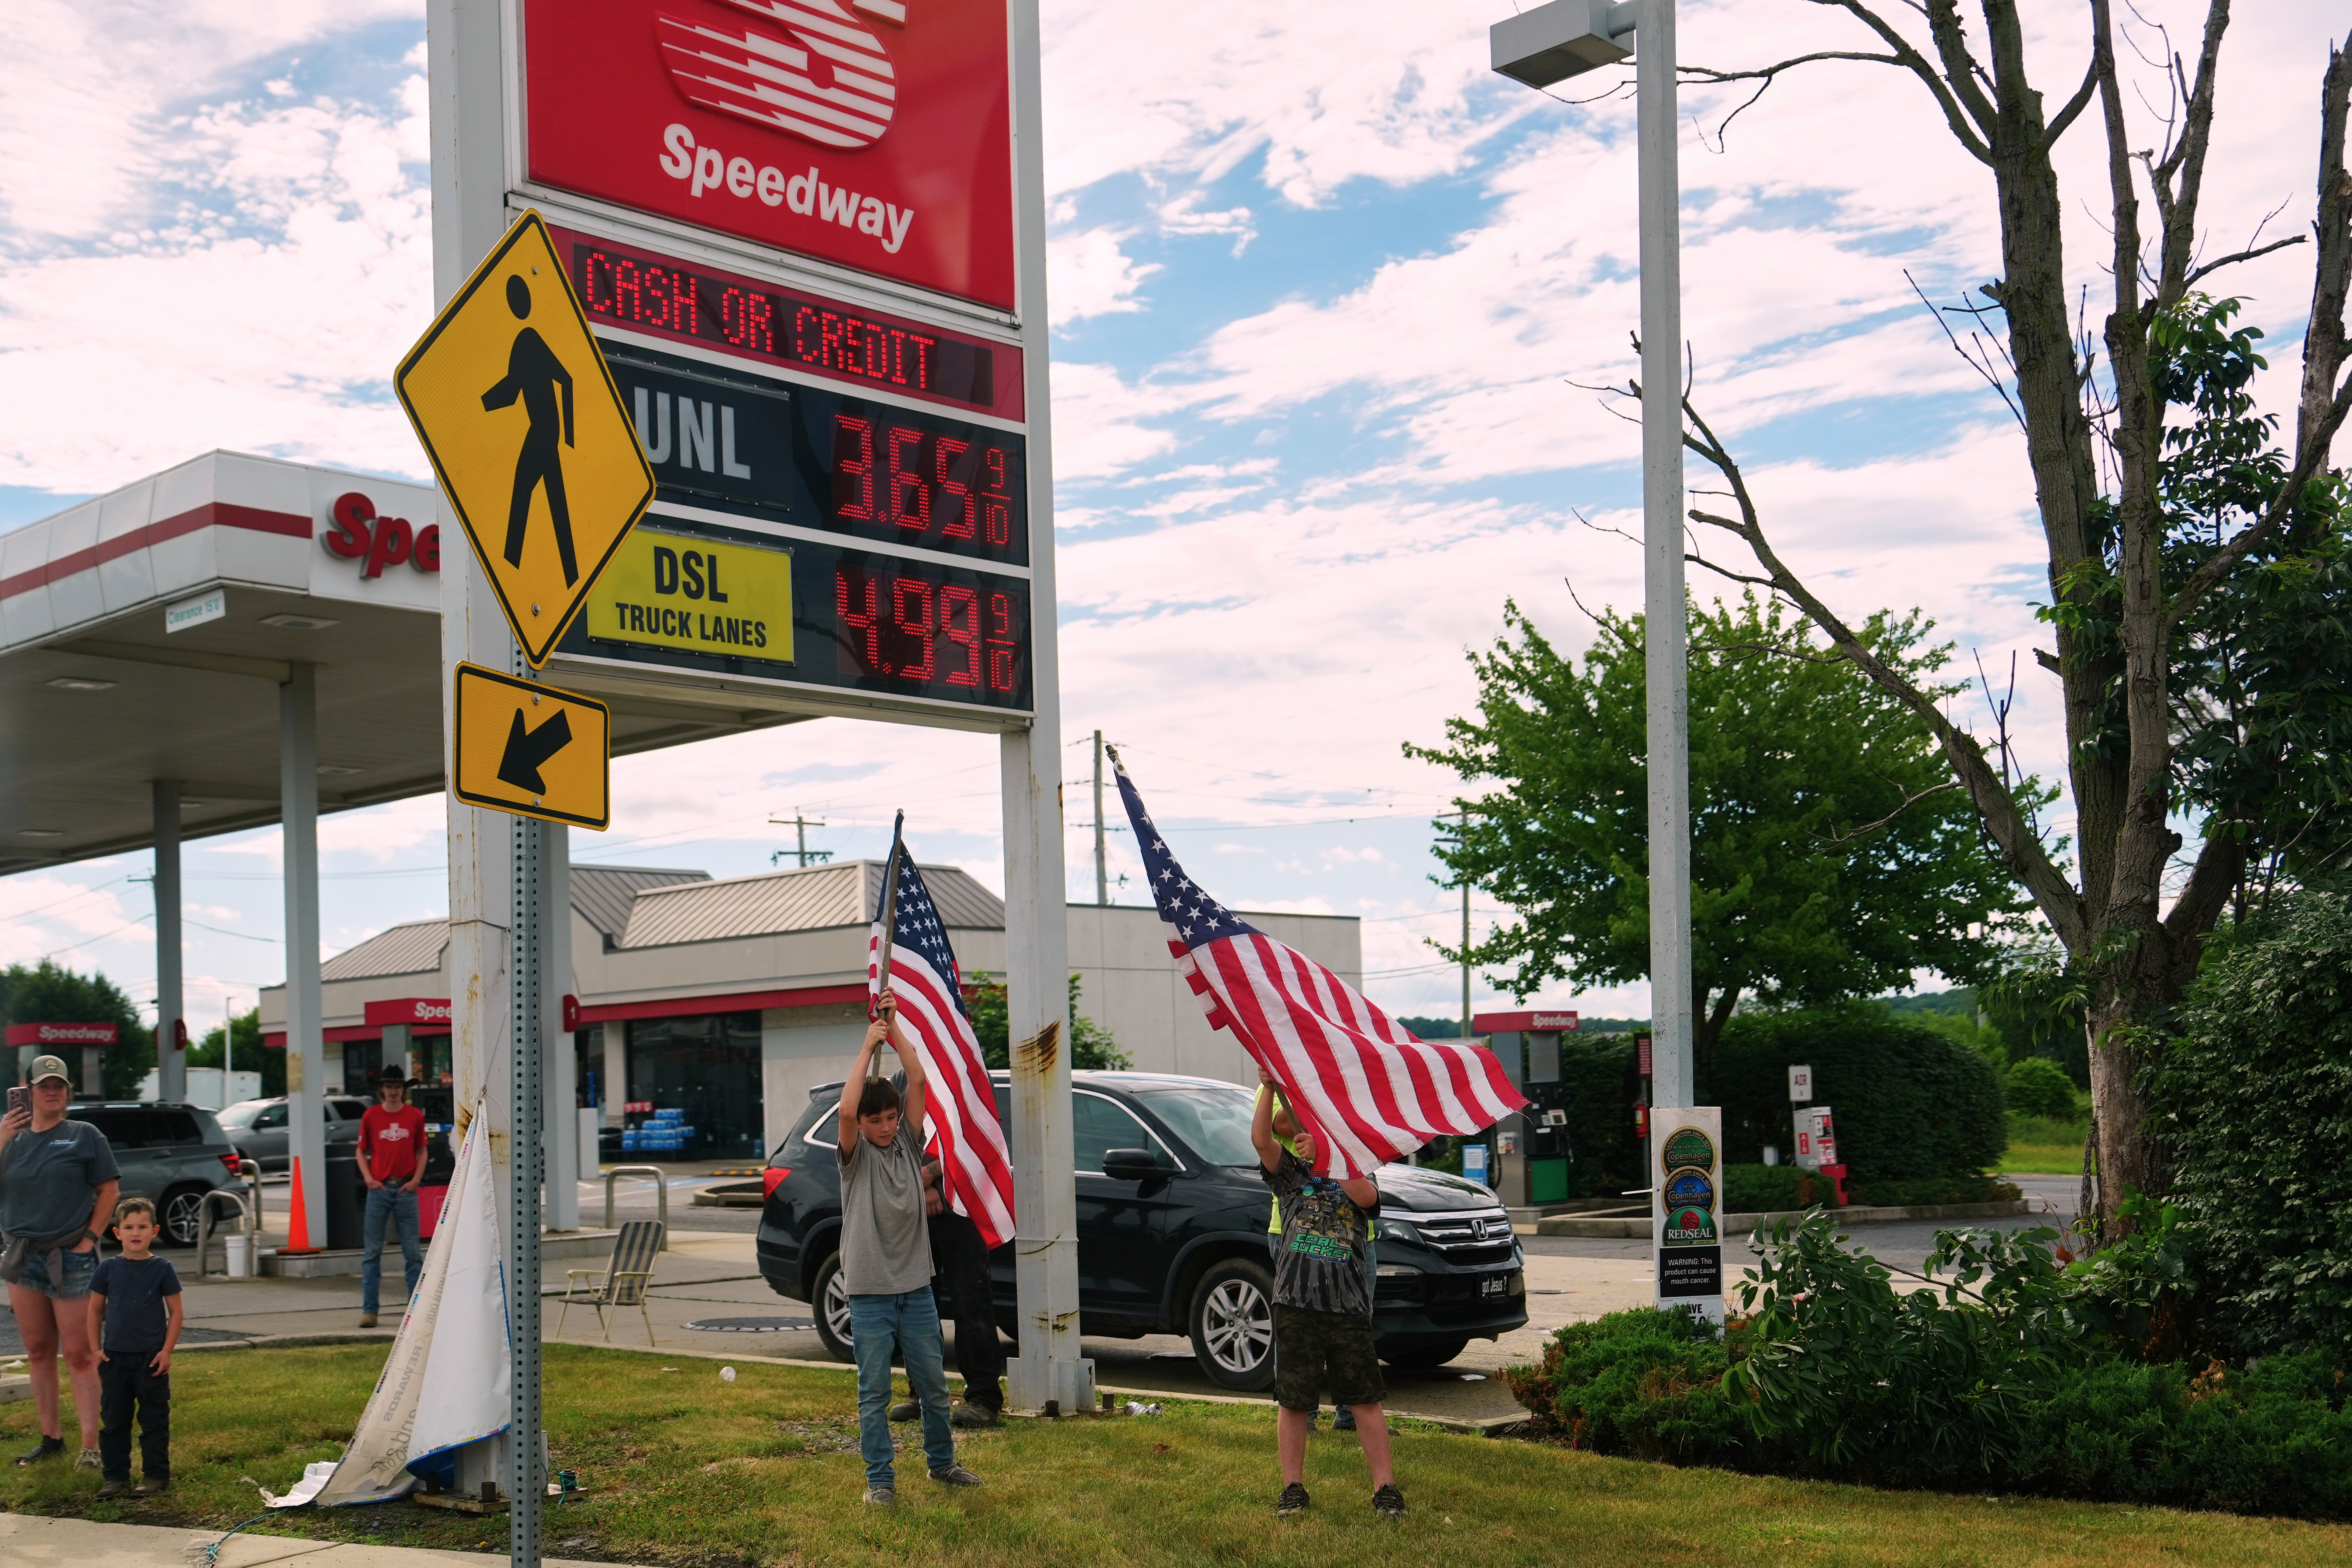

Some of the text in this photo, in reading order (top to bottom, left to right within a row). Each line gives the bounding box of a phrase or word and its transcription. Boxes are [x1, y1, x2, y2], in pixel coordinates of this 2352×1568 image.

[659, 123, 915, 254] Speedway
[586, 251, 935, 389] CASH OR CREDIT
[634, 386, 752, 480] UNL
[835, 413, 976, 539] 3.65
[326, 492, 440, 578] Spe
[654, 545, 729, 604] DSL
[169, 606, 202, 625] Clearance
[615, 602, 767, 649] TRUCK LANES
[837, 571, 979, 688] 4.99
[414, 1001, 452, 1020] Spee
[570, 1006, 576, 1019] 1
[1532, 1013, 1577, 1029] Speedway
[39, 1025, 114, 1042] Speedway
[1666, 1130, 1691, 1151] SATISFACTION
[1692, 1131, 1705, 1140] SINCE
[1667, 1151, 1710, 1163] Copenhagen
[1666, 1170, 1692, 1191] SATISFACTION
[1693, 1171, 1705, 1180] SINCE
[1668, 1191, 1710, 1203] Copenhagen
[1289, 1241, 1353, 1259] BUCKET
[1296, 1233, 1339, 1248] COAL
[1668, 1258, 1699, 1266] WARNING:
[1664, 1269, 1687, 1277] product
[1490, 1277, 1503, 1292] Jesus
